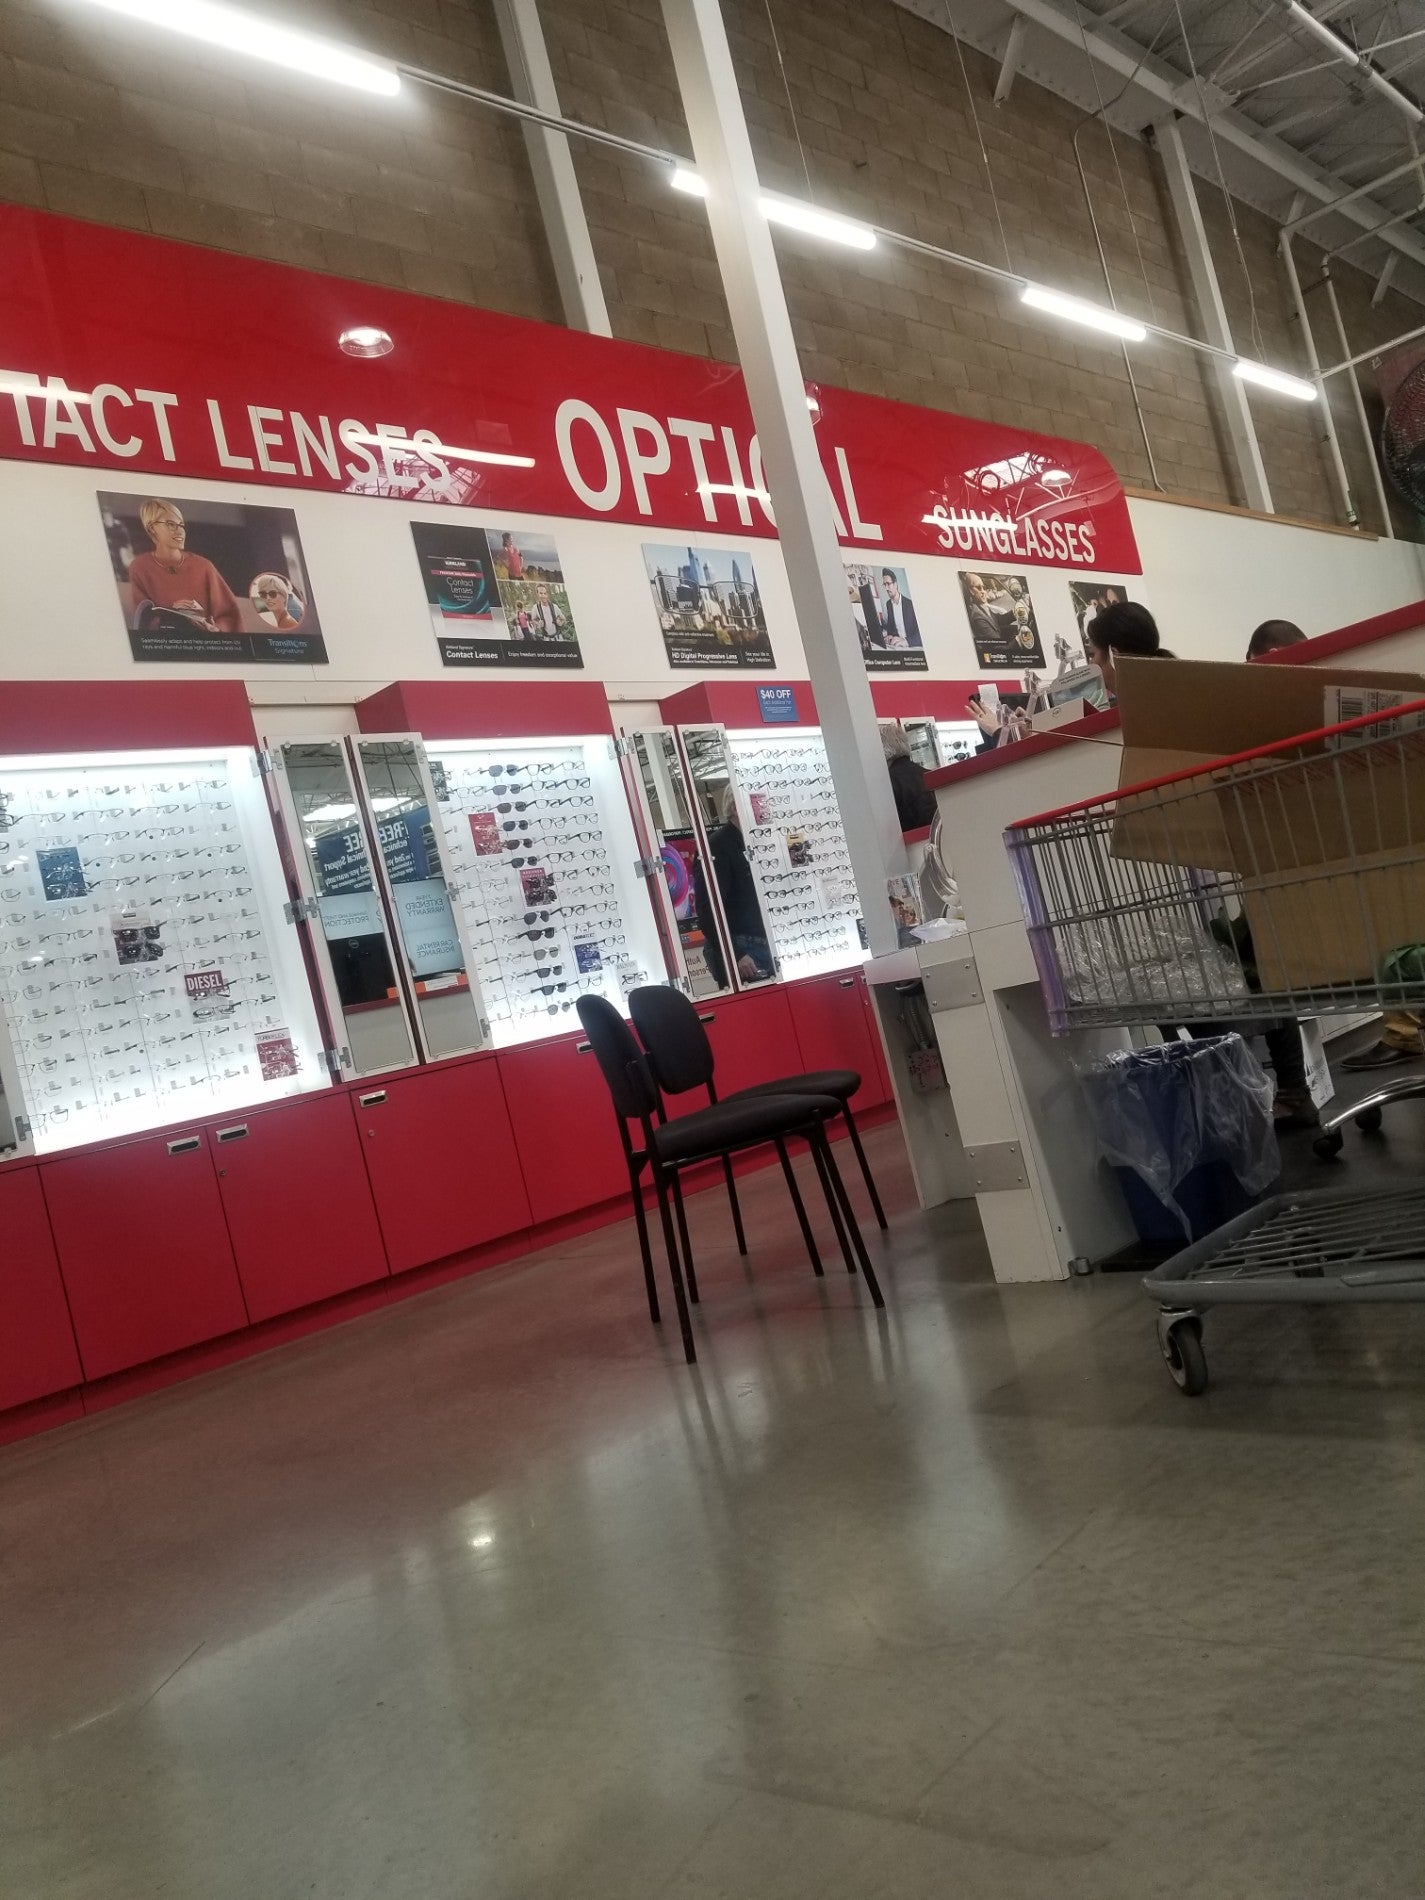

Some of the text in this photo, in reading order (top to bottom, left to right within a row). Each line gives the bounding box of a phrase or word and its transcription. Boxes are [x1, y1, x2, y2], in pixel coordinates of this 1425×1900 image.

[206, 399, 450, 493] LENSES
[555, 398, 883, 541] OPTIL
[933, 505, 1096, 563] SUNGLASSES
[446, 651, 498, 659] Contact Lenses
[680, 652, 697, 660] Digital
[697, 653, 725, 661] Progressive
[760, 689, 792, 699] $40 OFF
[186, 974, 222, 991] DIESEL
